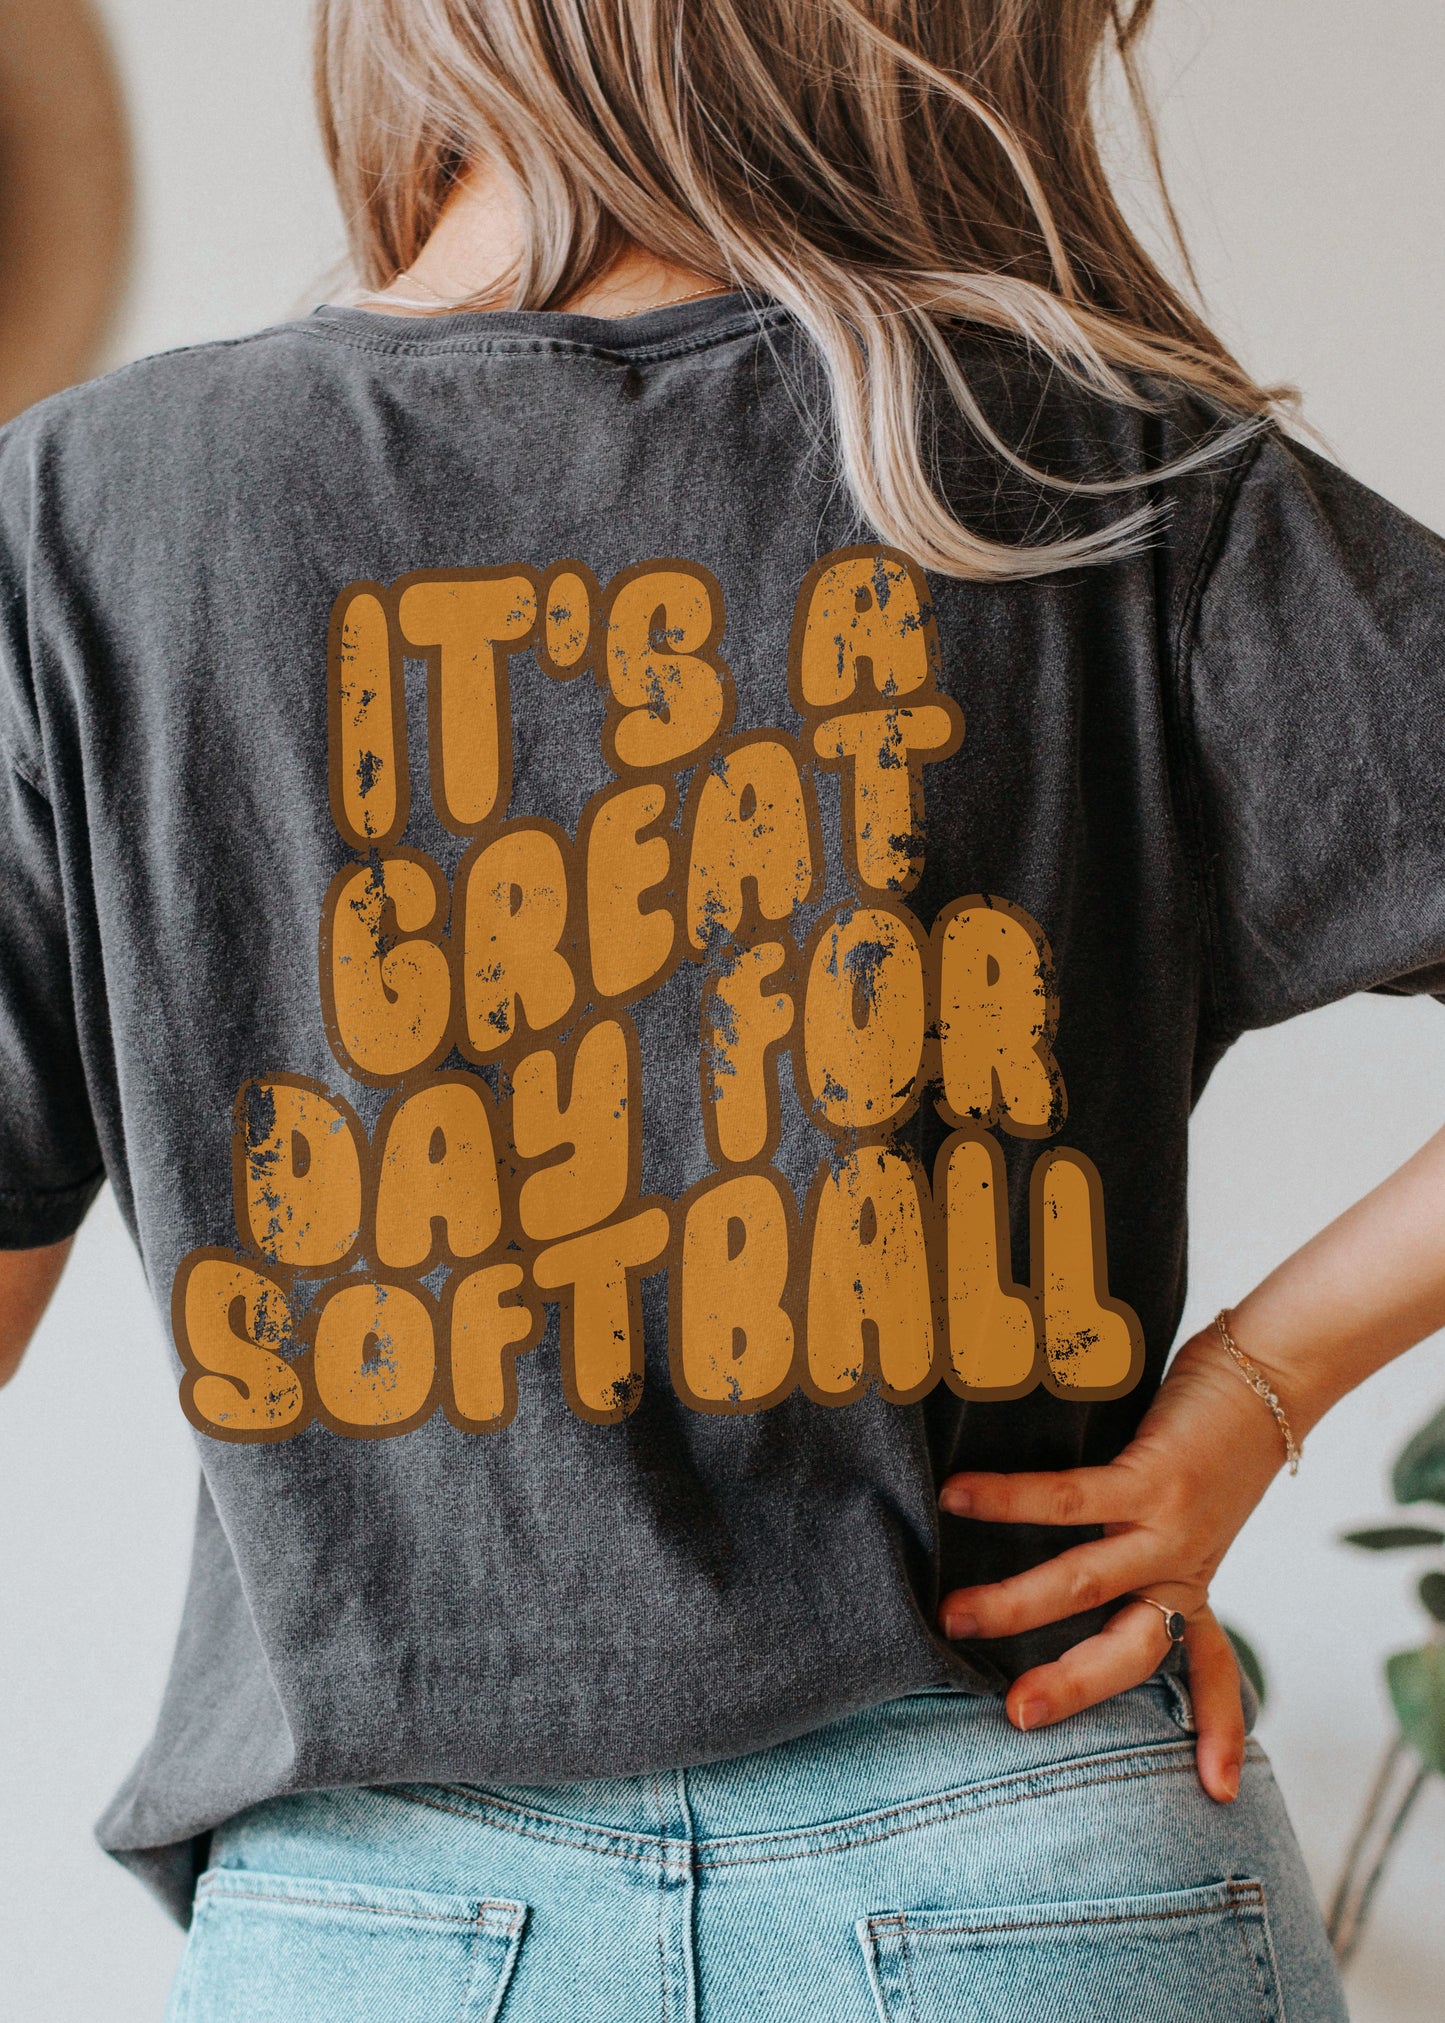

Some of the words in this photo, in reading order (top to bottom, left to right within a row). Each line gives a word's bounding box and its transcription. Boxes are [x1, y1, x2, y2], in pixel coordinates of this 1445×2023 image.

[337, 569, 725, 842] IT'S
[800, 555, 929, 708] A
[331, 704, 953, 1075] GREAT
[245, 1018, 630, 1268] DAY
[708, 906, 1057, 1164] FOR
[185, 1139, 1134, 1430] SOFTBALL
